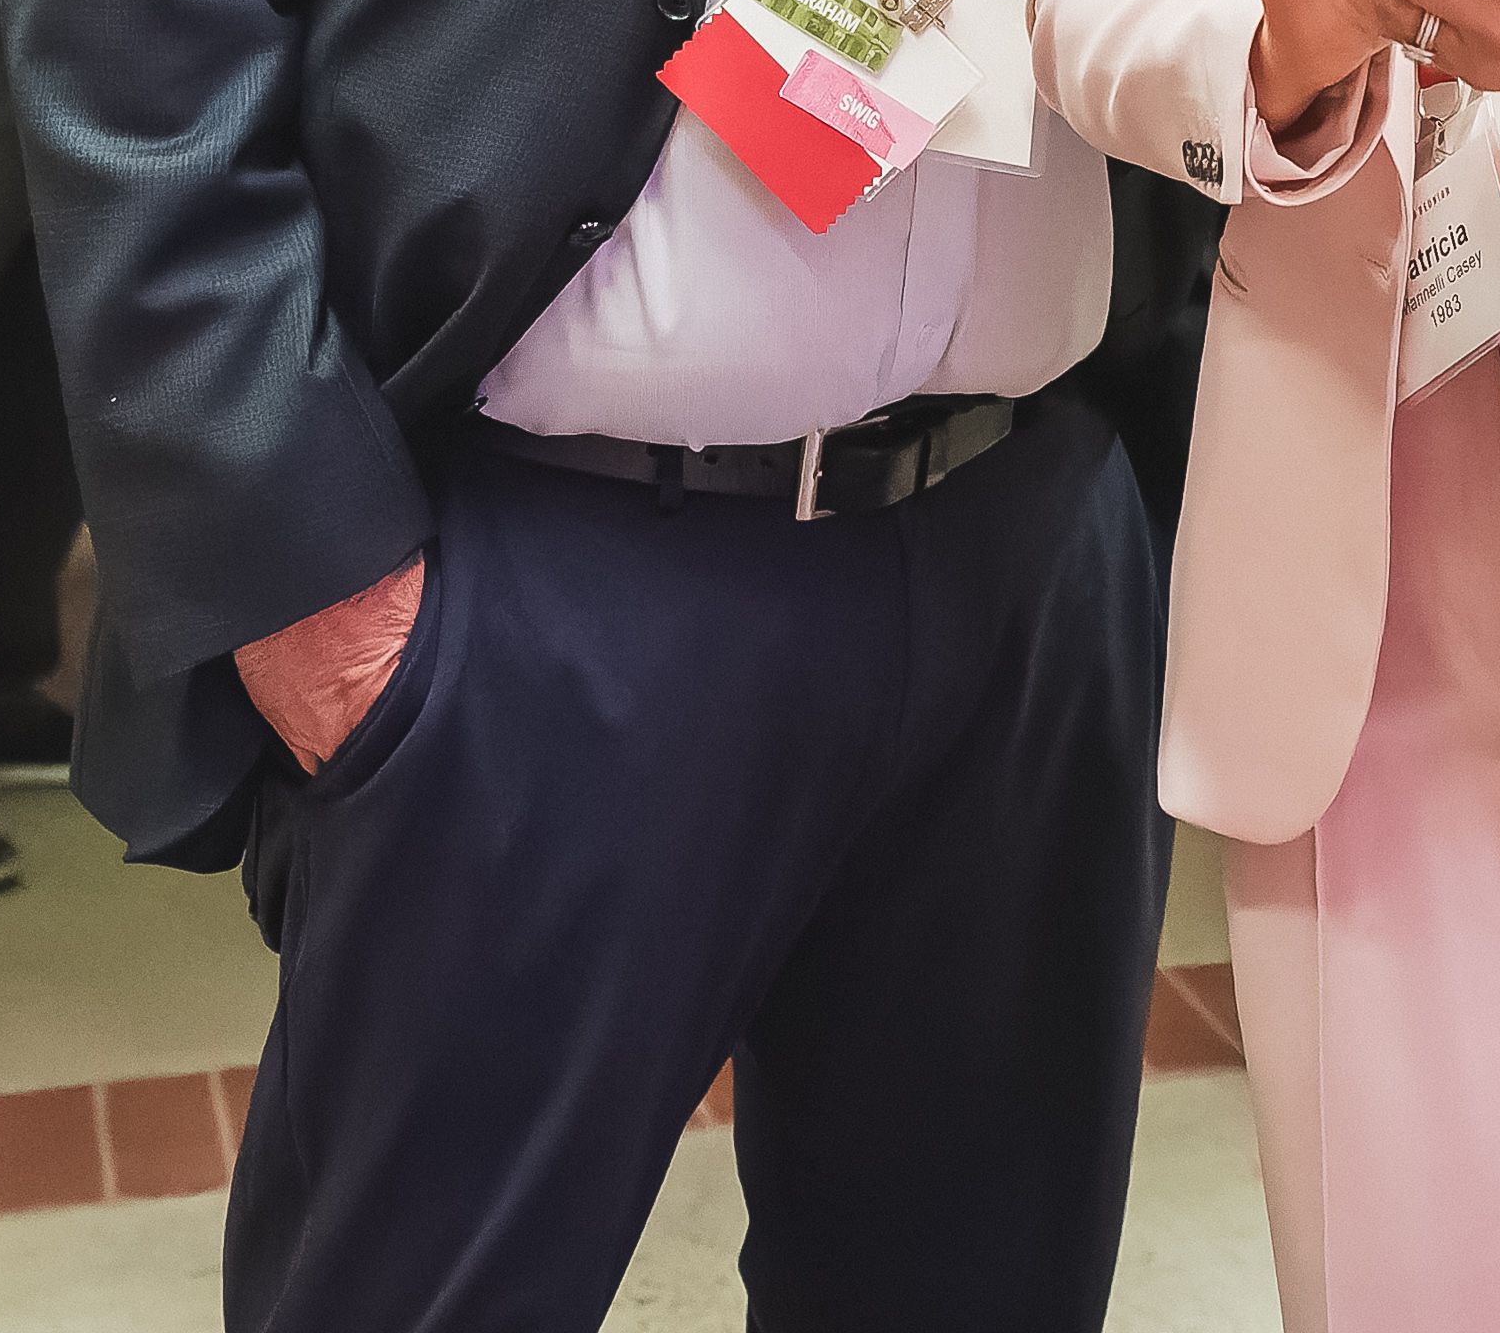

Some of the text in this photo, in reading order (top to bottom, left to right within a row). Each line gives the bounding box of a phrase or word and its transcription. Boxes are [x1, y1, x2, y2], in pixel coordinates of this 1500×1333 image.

[839, 94, 881, 129] SWIG
[1408, 224, 1469, 281] atricia
[1446, 249, 1483, 284] Casey
[1430, 293, 1463, 328] 1983
